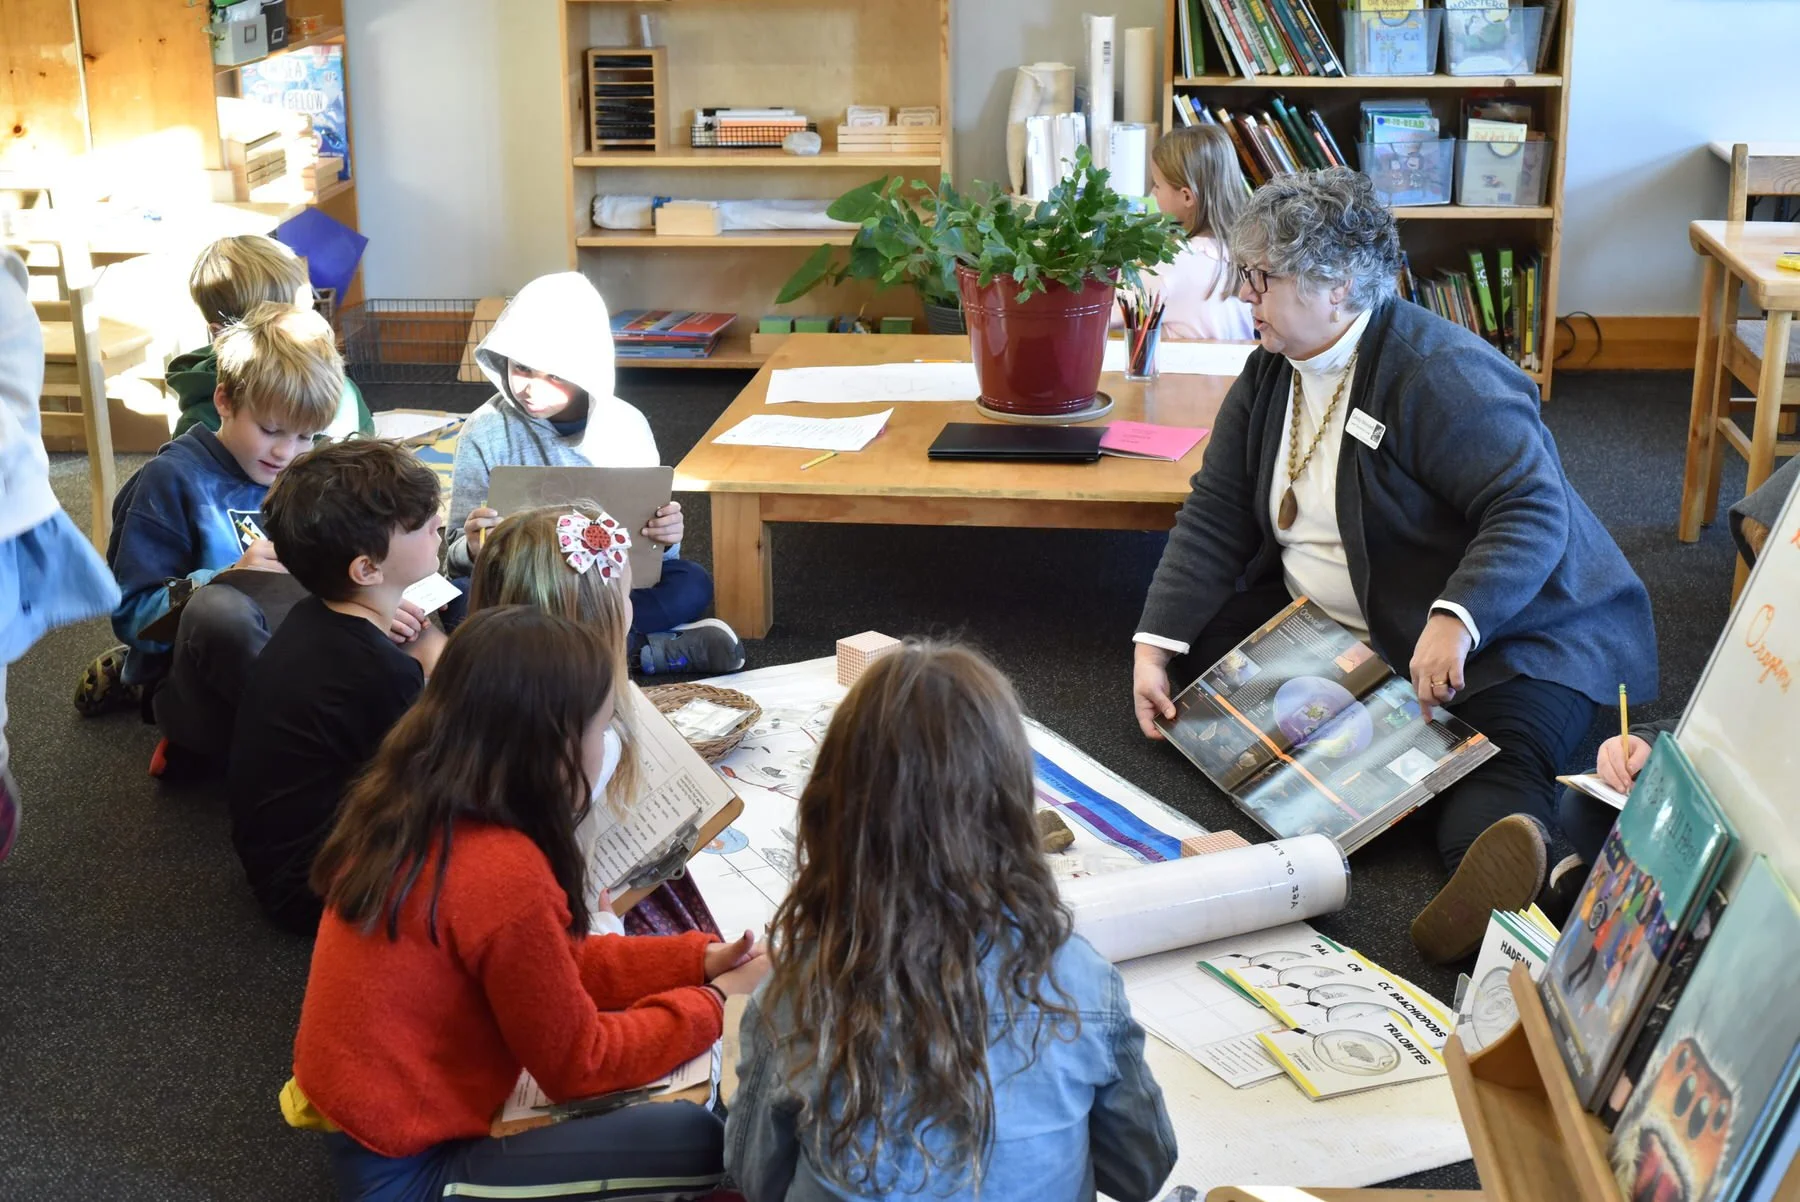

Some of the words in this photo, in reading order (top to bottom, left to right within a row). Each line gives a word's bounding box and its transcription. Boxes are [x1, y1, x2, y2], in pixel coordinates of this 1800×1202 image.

[287, 92, 323, 110] BELOW
[1388, 992, 1447, 1038] BRACHIOPODS
[1384, 1022, 1431, 1066] TRILOBITES
